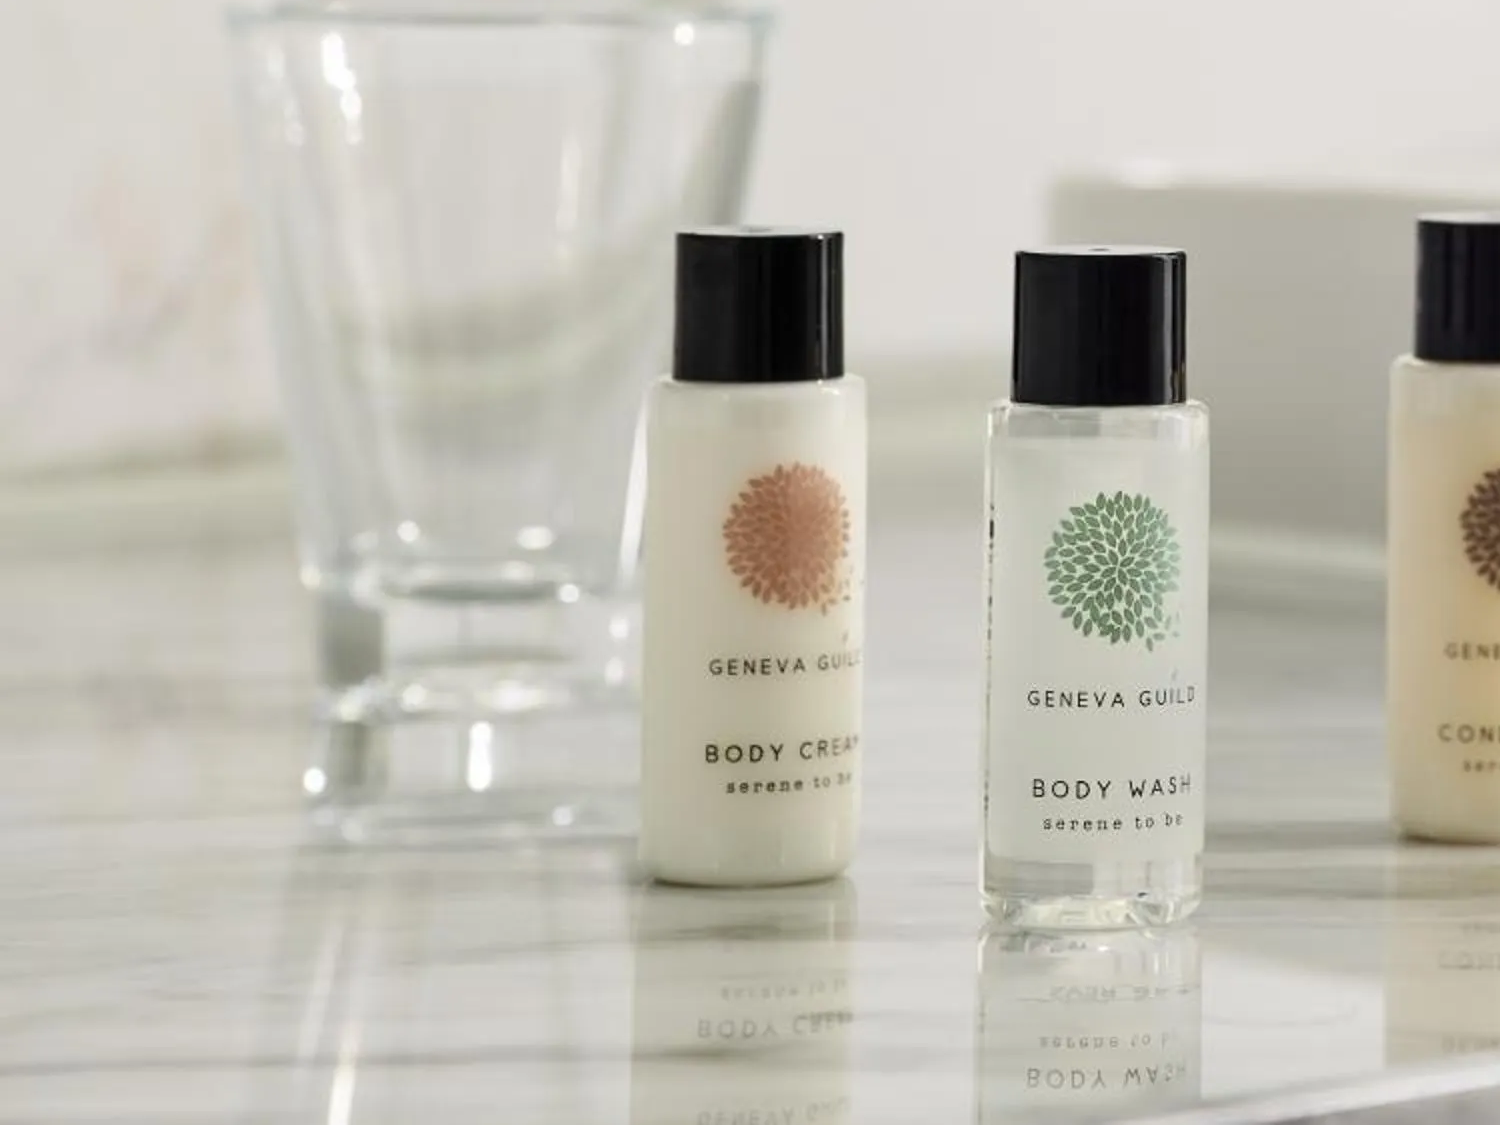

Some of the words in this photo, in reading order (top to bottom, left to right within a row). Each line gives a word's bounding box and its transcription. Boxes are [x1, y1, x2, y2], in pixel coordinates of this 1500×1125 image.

[708, 657, 806, 676] GENEVA
[1027, 690, 1125, 708] GENEVA
[1138, 685, 1196, 708] GUILD
[705, 744, 785, 764] BODY
[725, 779, 804, 794] serene
[1032, 778, 1112, 799] BODY
[1128, 772, 1192, 799] WASH
[1042, 817, 1124, 832] serene
[1135, 814, 1156, 830] to
[1164, 811, 1185, 827] be
